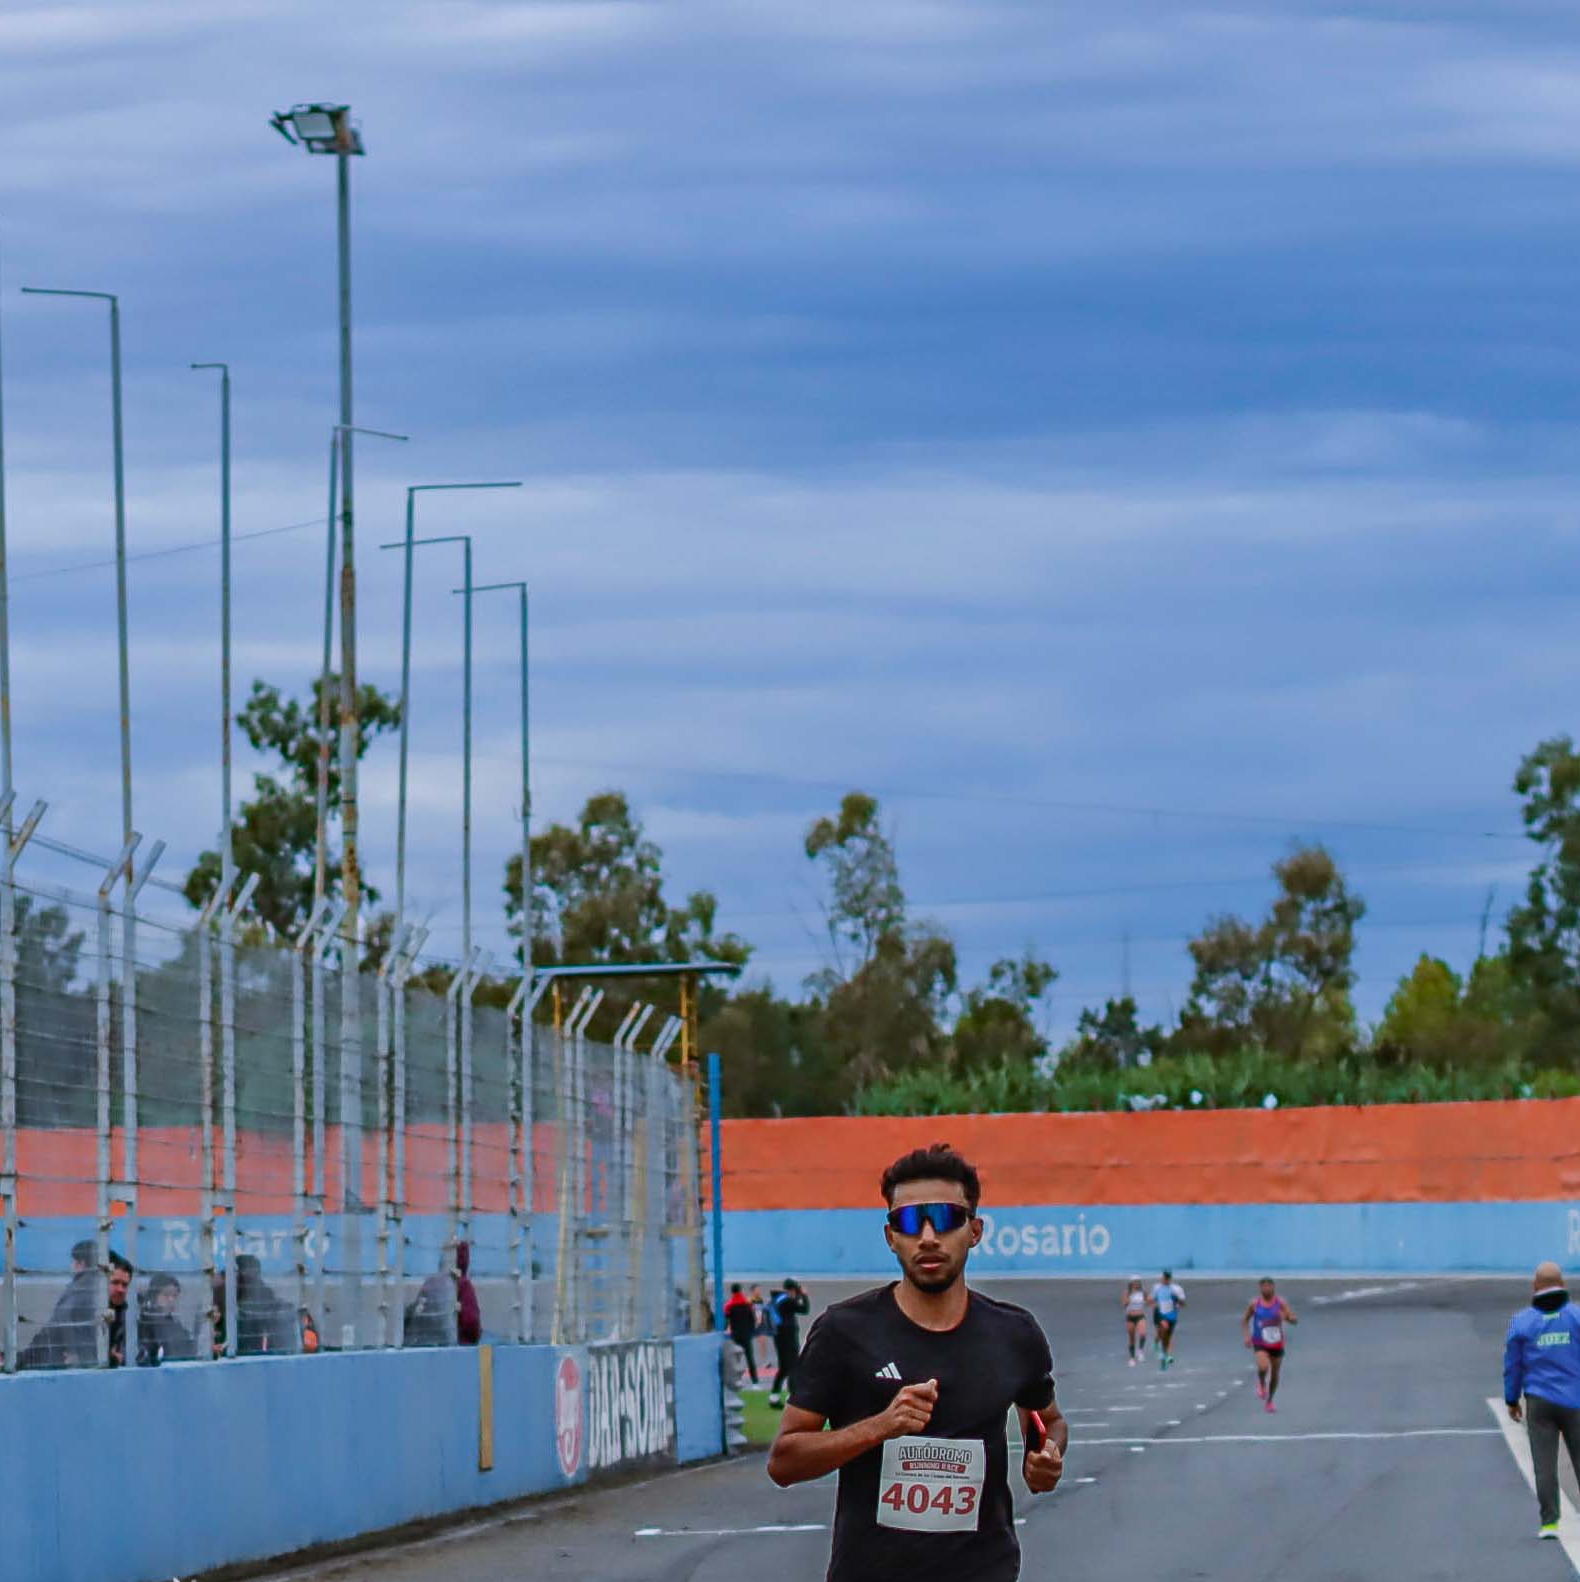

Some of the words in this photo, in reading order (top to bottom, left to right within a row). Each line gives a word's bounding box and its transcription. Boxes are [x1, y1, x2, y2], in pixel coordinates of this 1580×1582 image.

[972, 1212, 1111, 1257] Rosario
[899, 1442, 973, 1464] AUTÓDROMO
[882, 1483, 977, 1515] 4043
